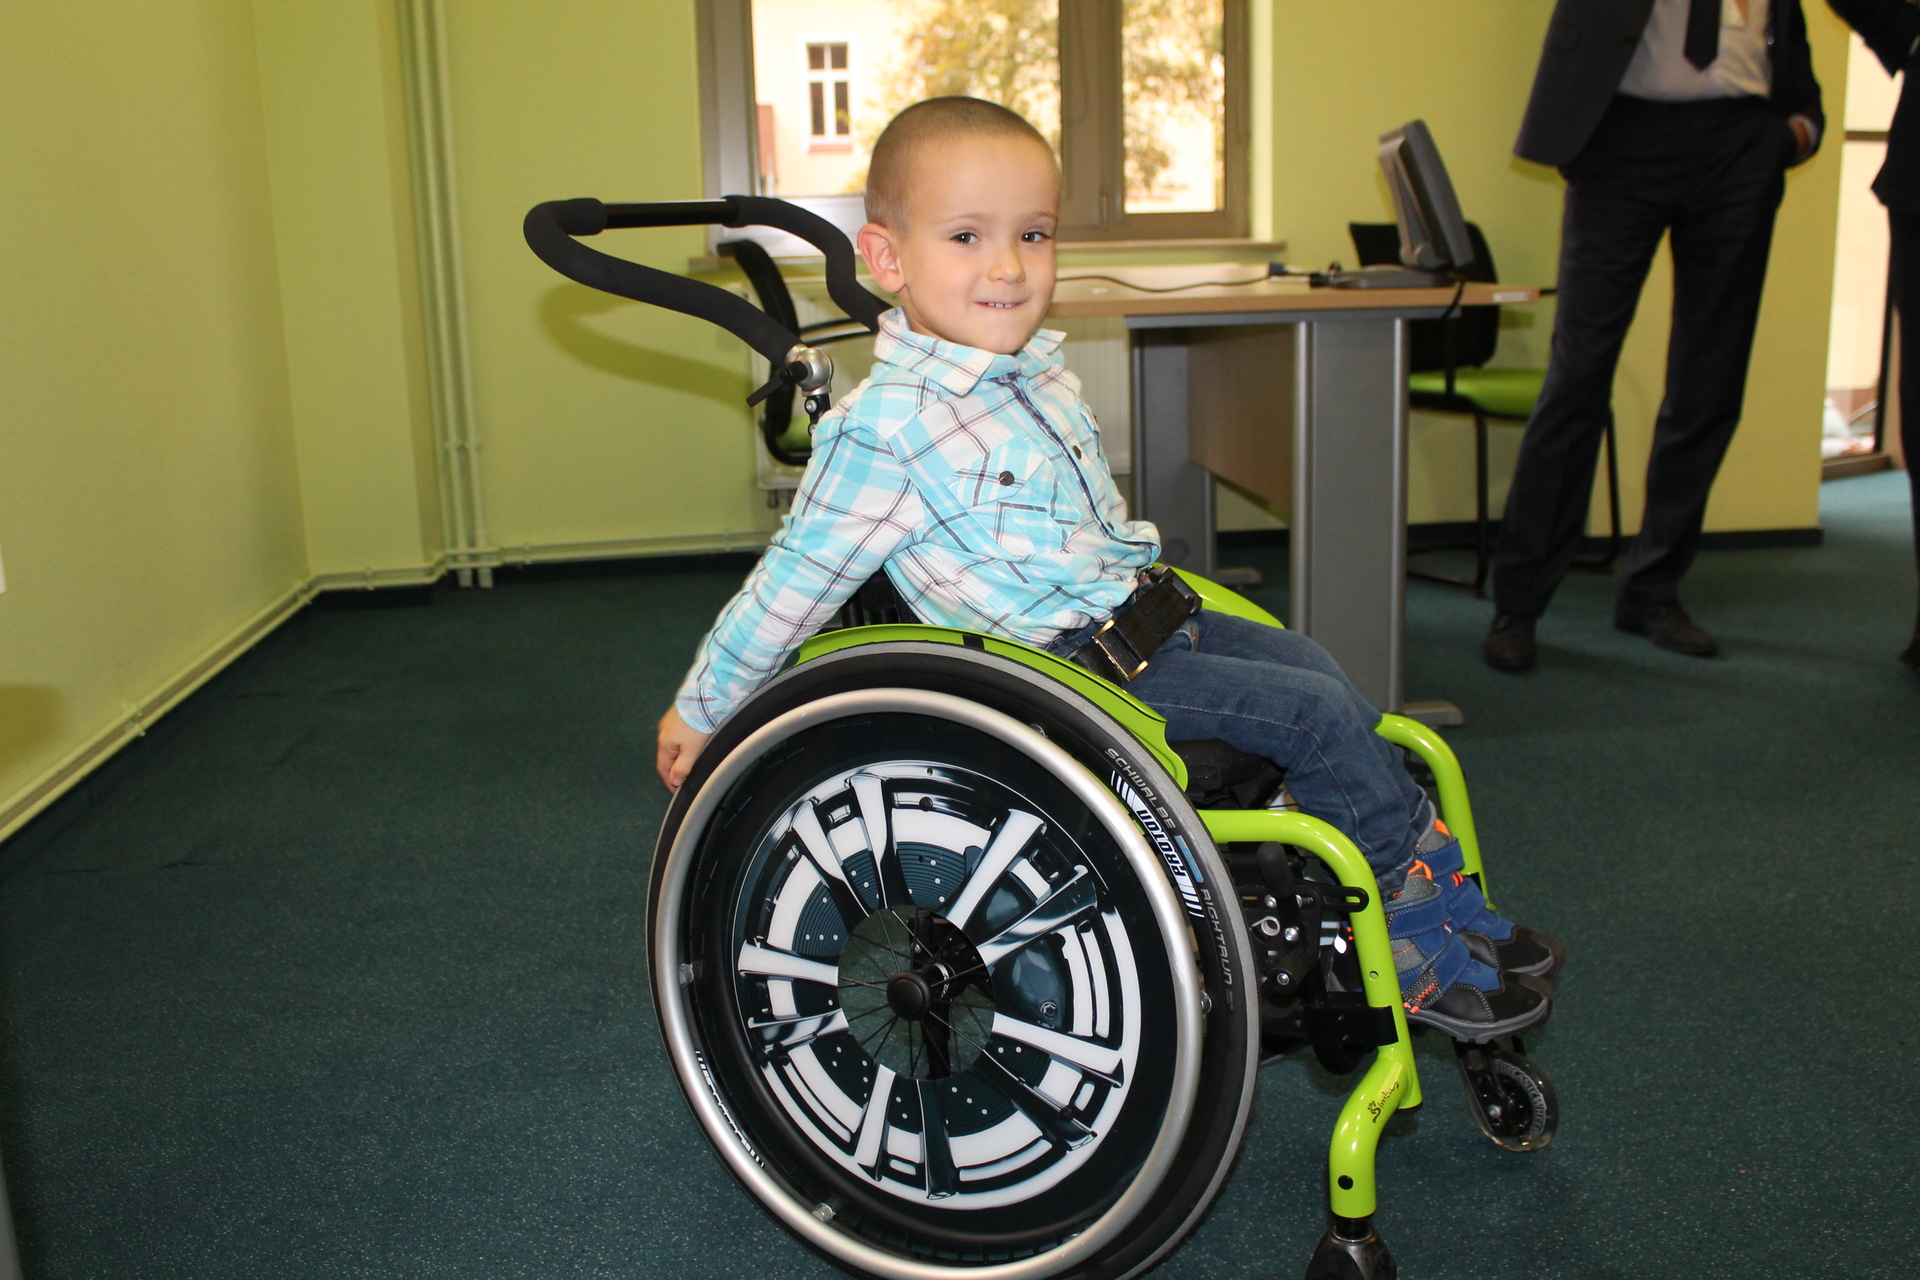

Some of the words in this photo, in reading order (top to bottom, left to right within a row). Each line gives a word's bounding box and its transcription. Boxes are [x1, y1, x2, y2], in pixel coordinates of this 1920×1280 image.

[1105, 748, 1176, 829] SCHWALBE
[1135, 809, 1187, 877] PROTON
[1200, 888, 1233, 986] RIGHTRUN
[1367, 1081, 1400, 1123] Simba
